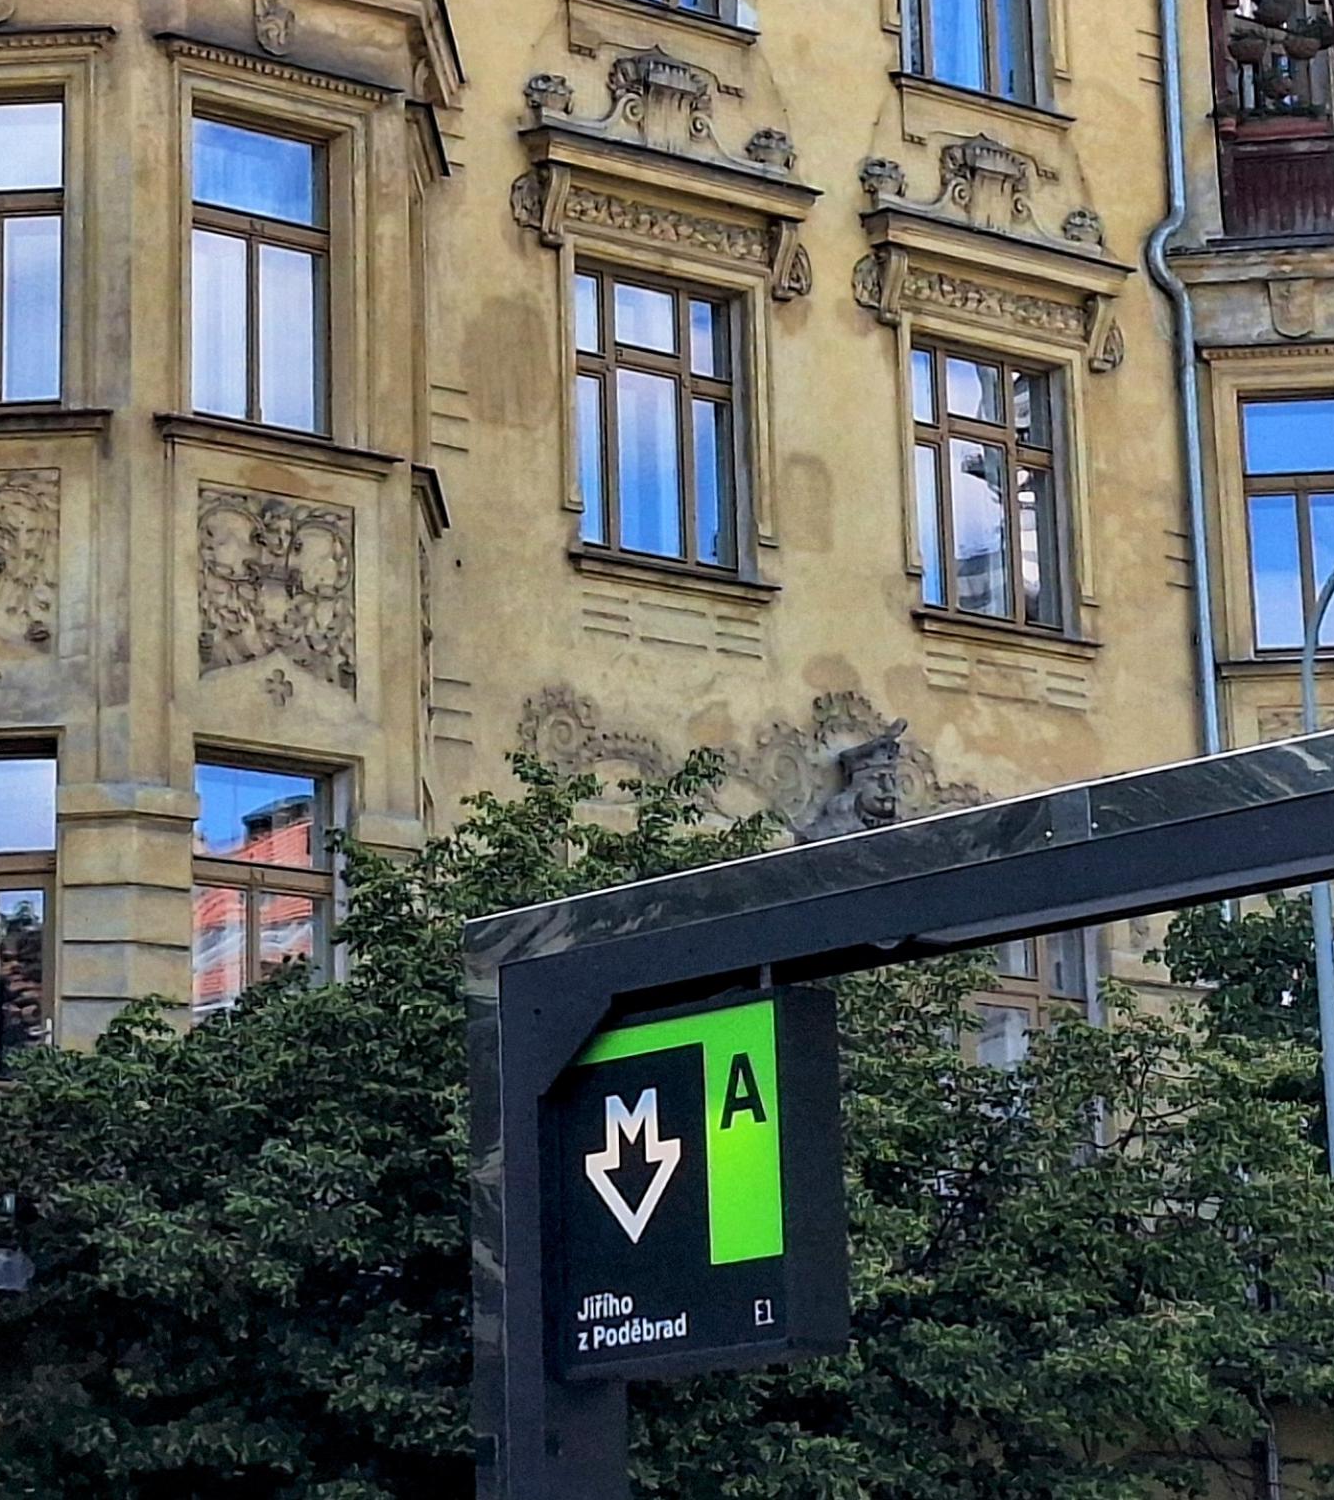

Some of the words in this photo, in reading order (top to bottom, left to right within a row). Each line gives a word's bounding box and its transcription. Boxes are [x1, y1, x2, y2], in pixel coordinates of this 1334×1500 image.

[720, 1052, 766, 1129] A
[577, 1293, 633, 1321] Jiřího
[578, 1332, 589, 1351] z
[593, 1312, 687, 1349] Poděbrad
